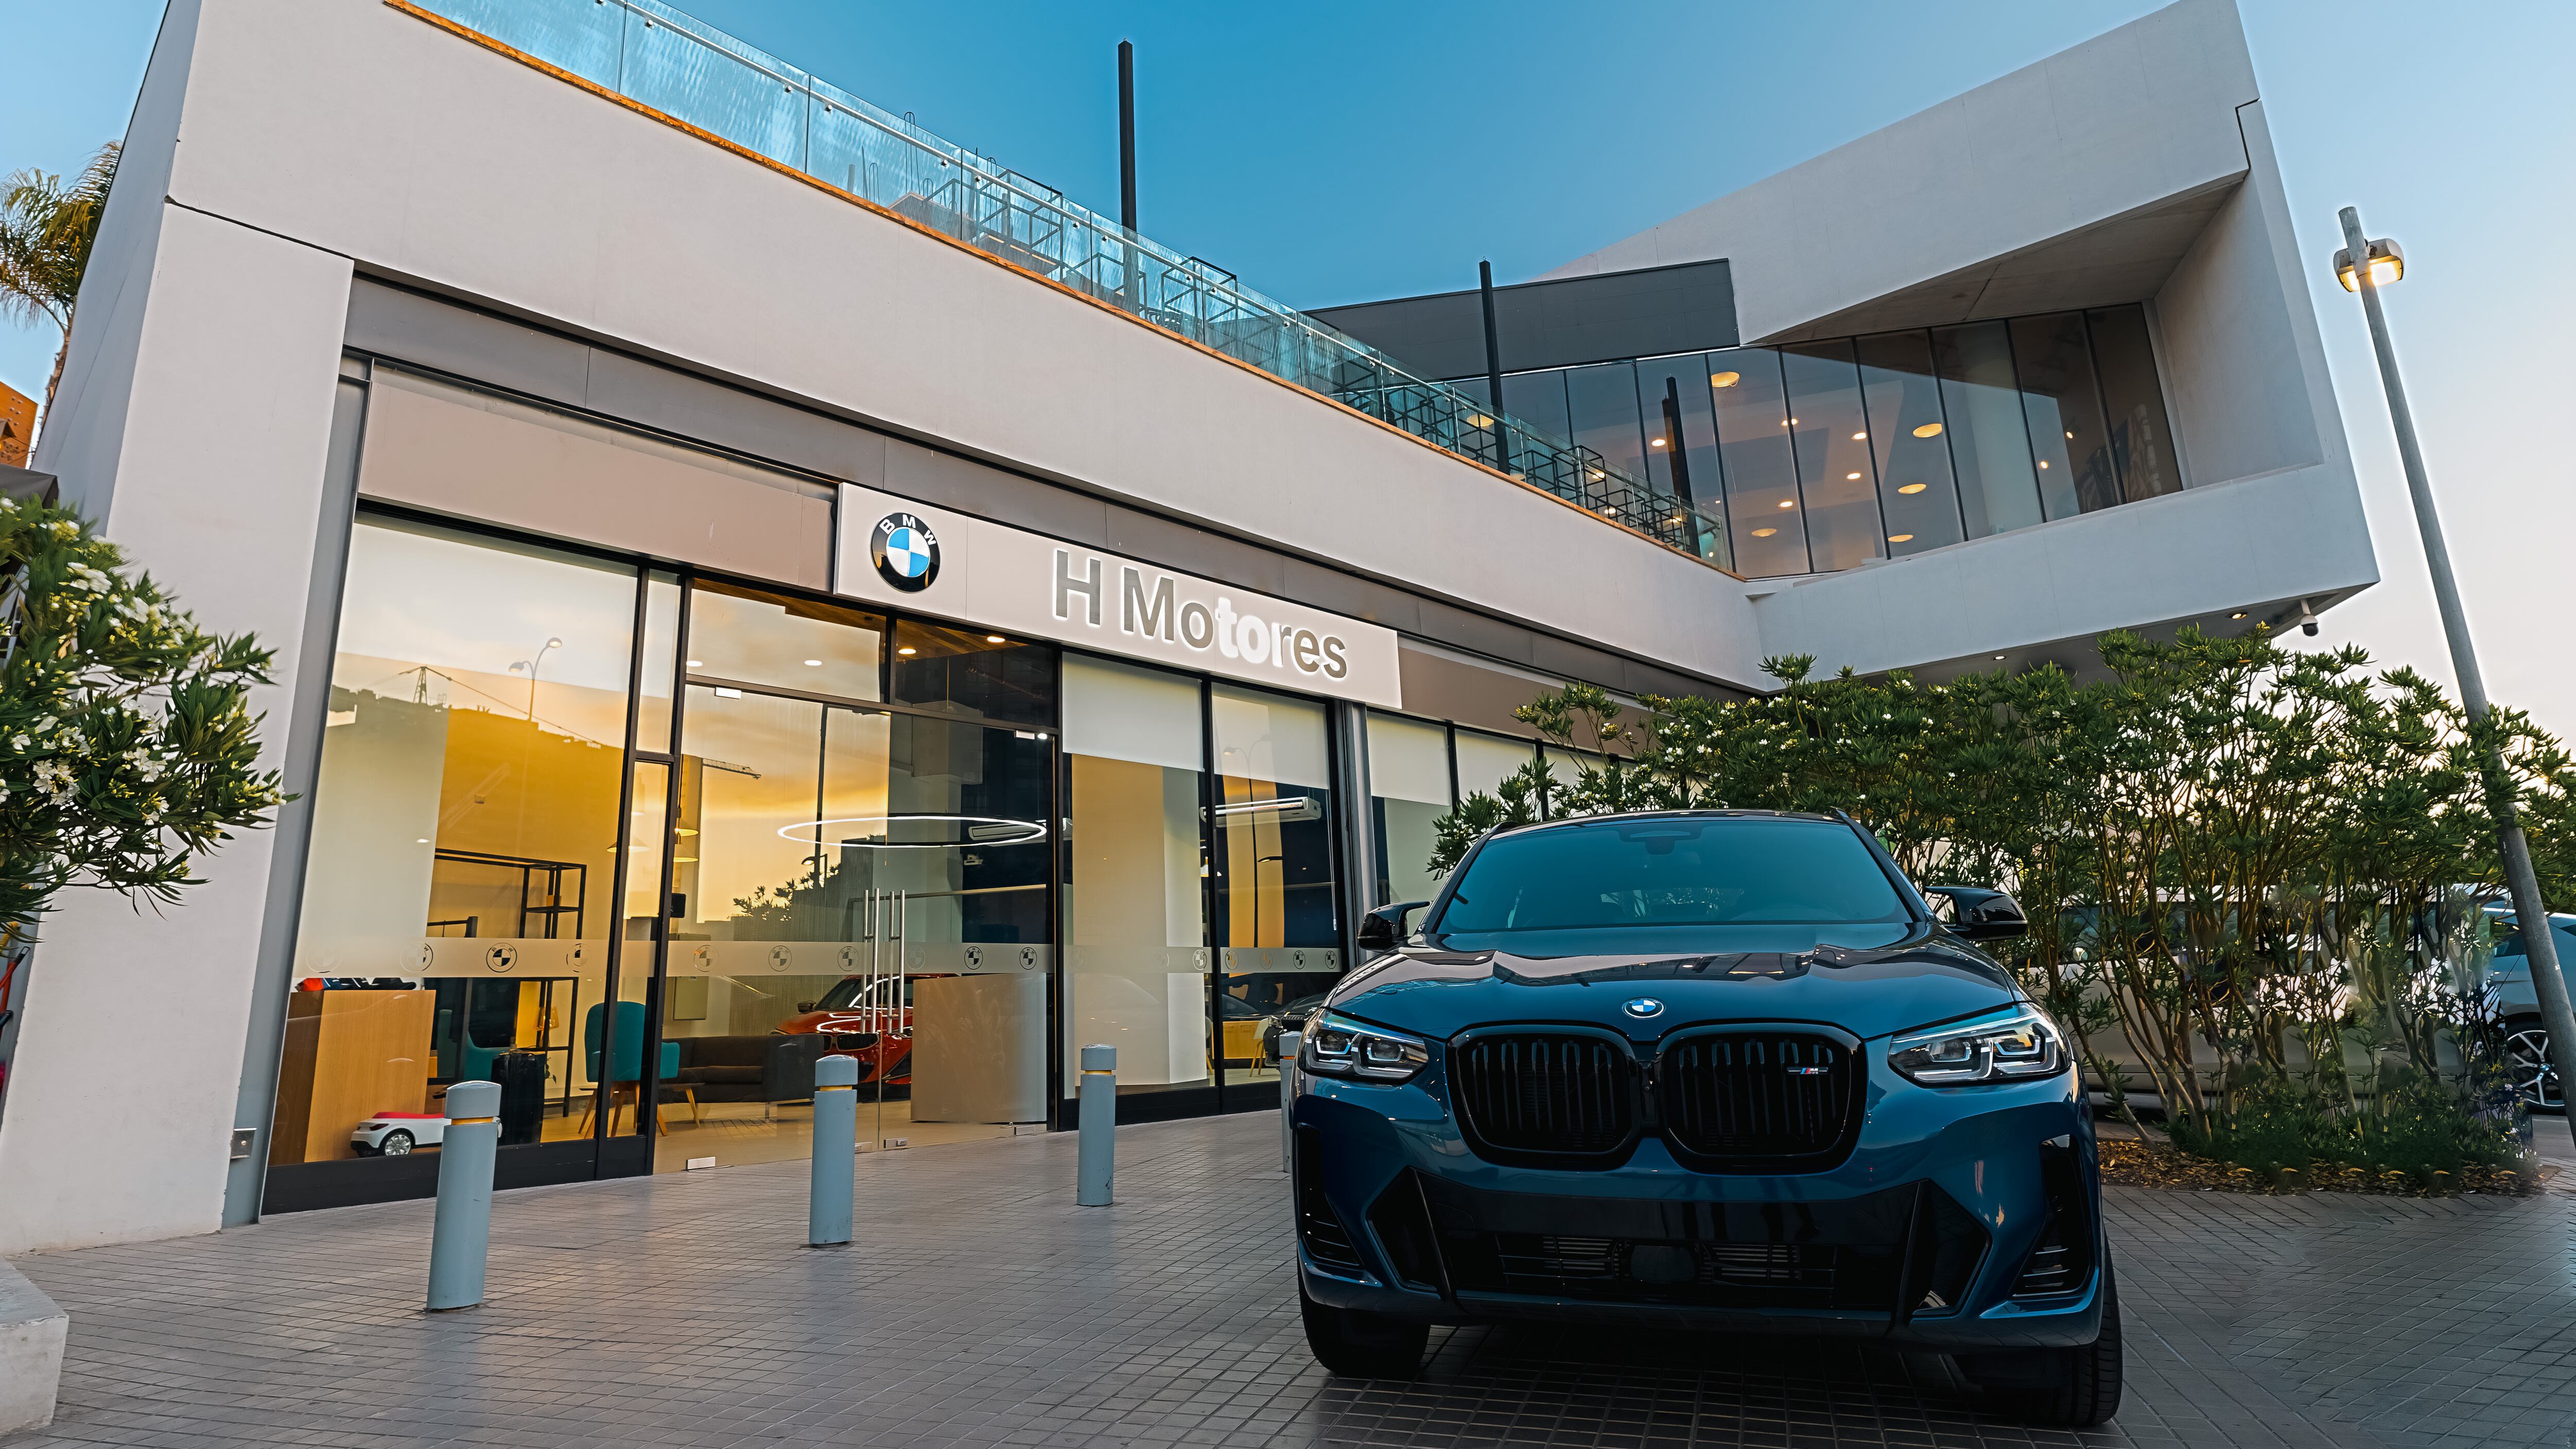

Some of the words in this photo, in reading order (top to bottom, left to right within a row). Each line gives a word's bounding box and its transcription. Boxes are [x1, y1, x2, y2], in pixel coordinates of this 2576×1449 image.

[879, 515, 937, 545] BMW
[1055, 550, 1101, 626] H
[1123, 567, 1348, 679] Motores
